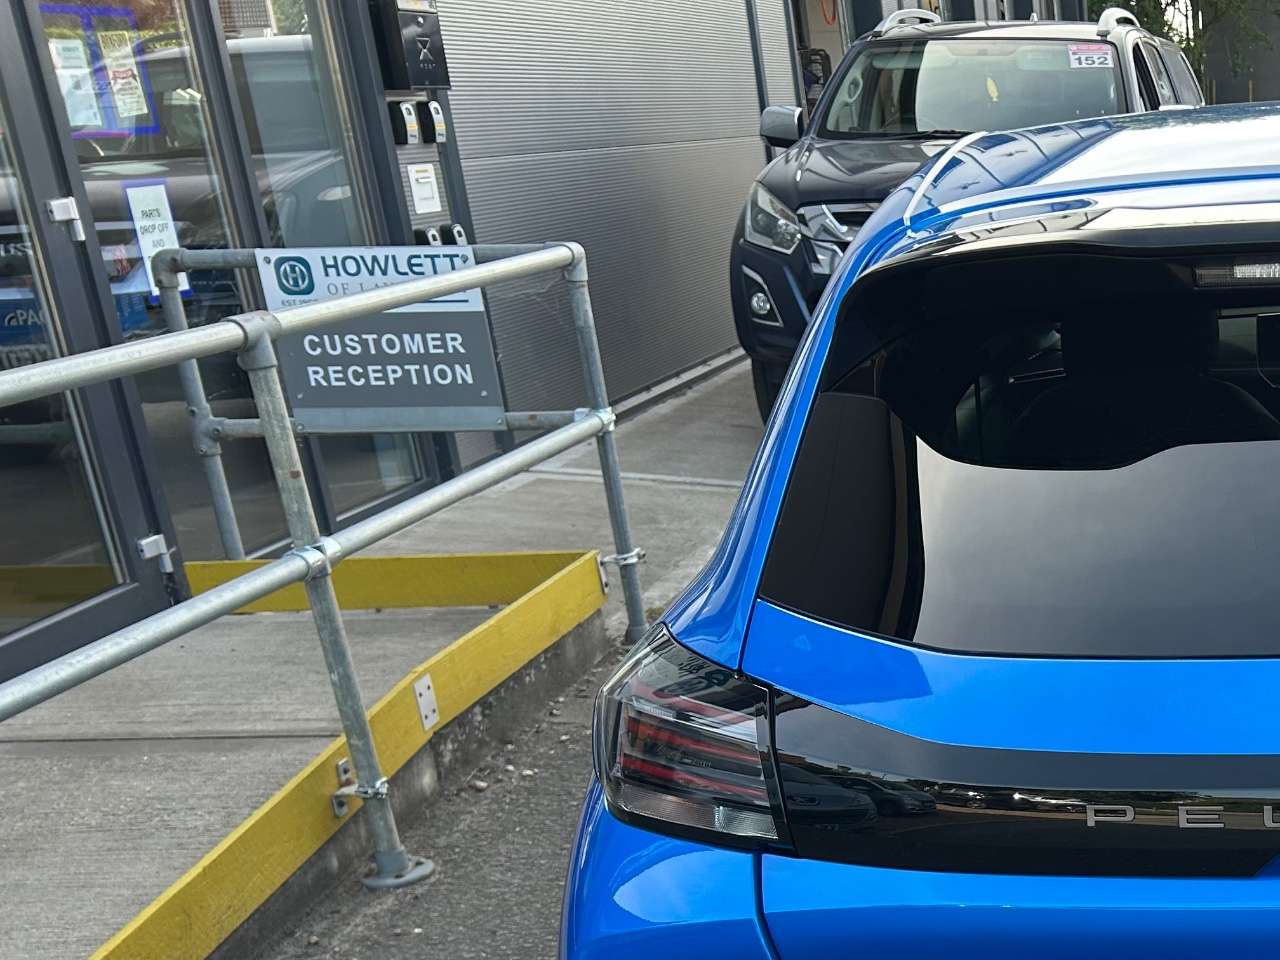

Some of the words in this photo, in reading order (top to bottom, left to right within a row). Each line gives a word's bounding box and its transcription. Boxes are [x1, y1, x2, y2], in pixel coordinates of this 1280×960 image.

[1074, 56, 1109, 66] 152
[320, 253, 460, 277] HOWLETT
[327, 282, 350, 296] OF
[303, 333, 466, 356] CUSTOMER
[306, 364, 474, 387] RECEPTION
